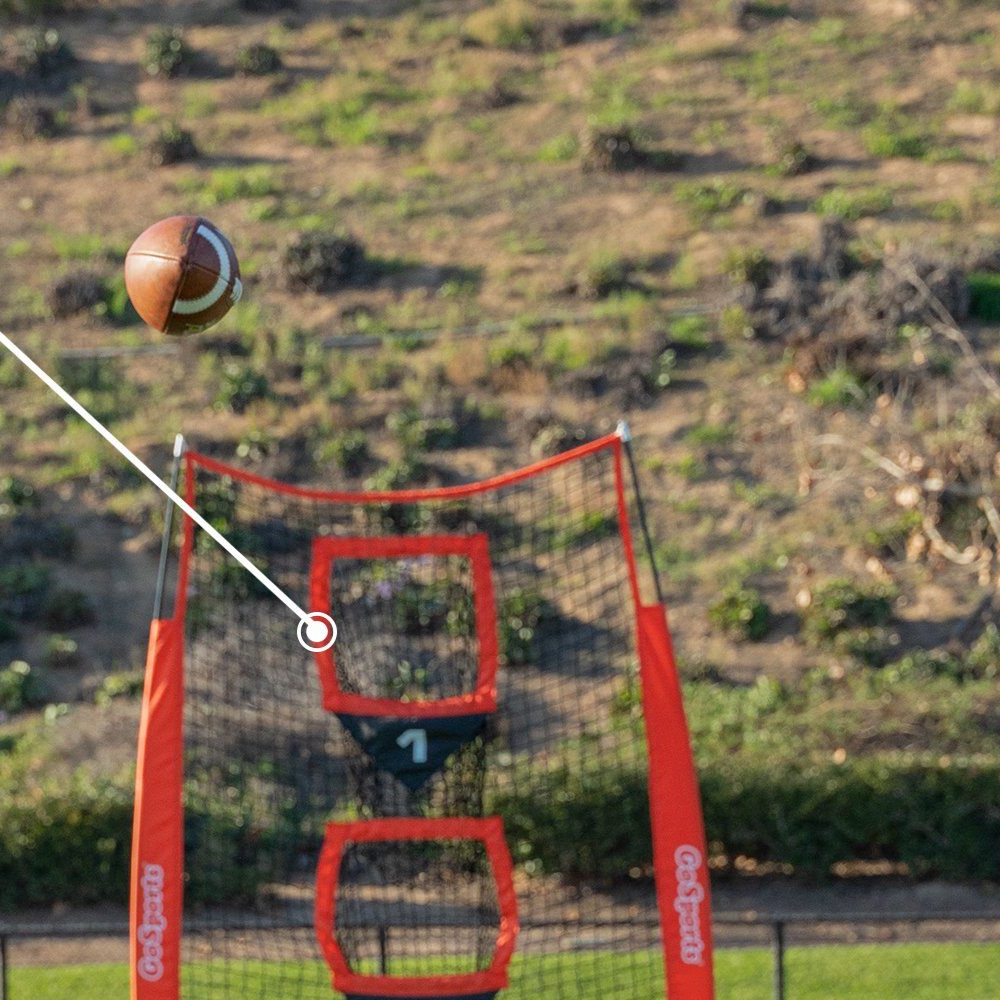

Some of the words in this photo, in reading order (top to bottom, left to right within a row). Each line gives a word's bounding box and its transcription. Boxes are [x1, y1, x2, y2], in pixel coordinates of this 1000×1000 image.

[396, 729, 427, 763] 1
[137, 863, 168, 982] GoSports
[674, 844, 705, 967] GoSports
